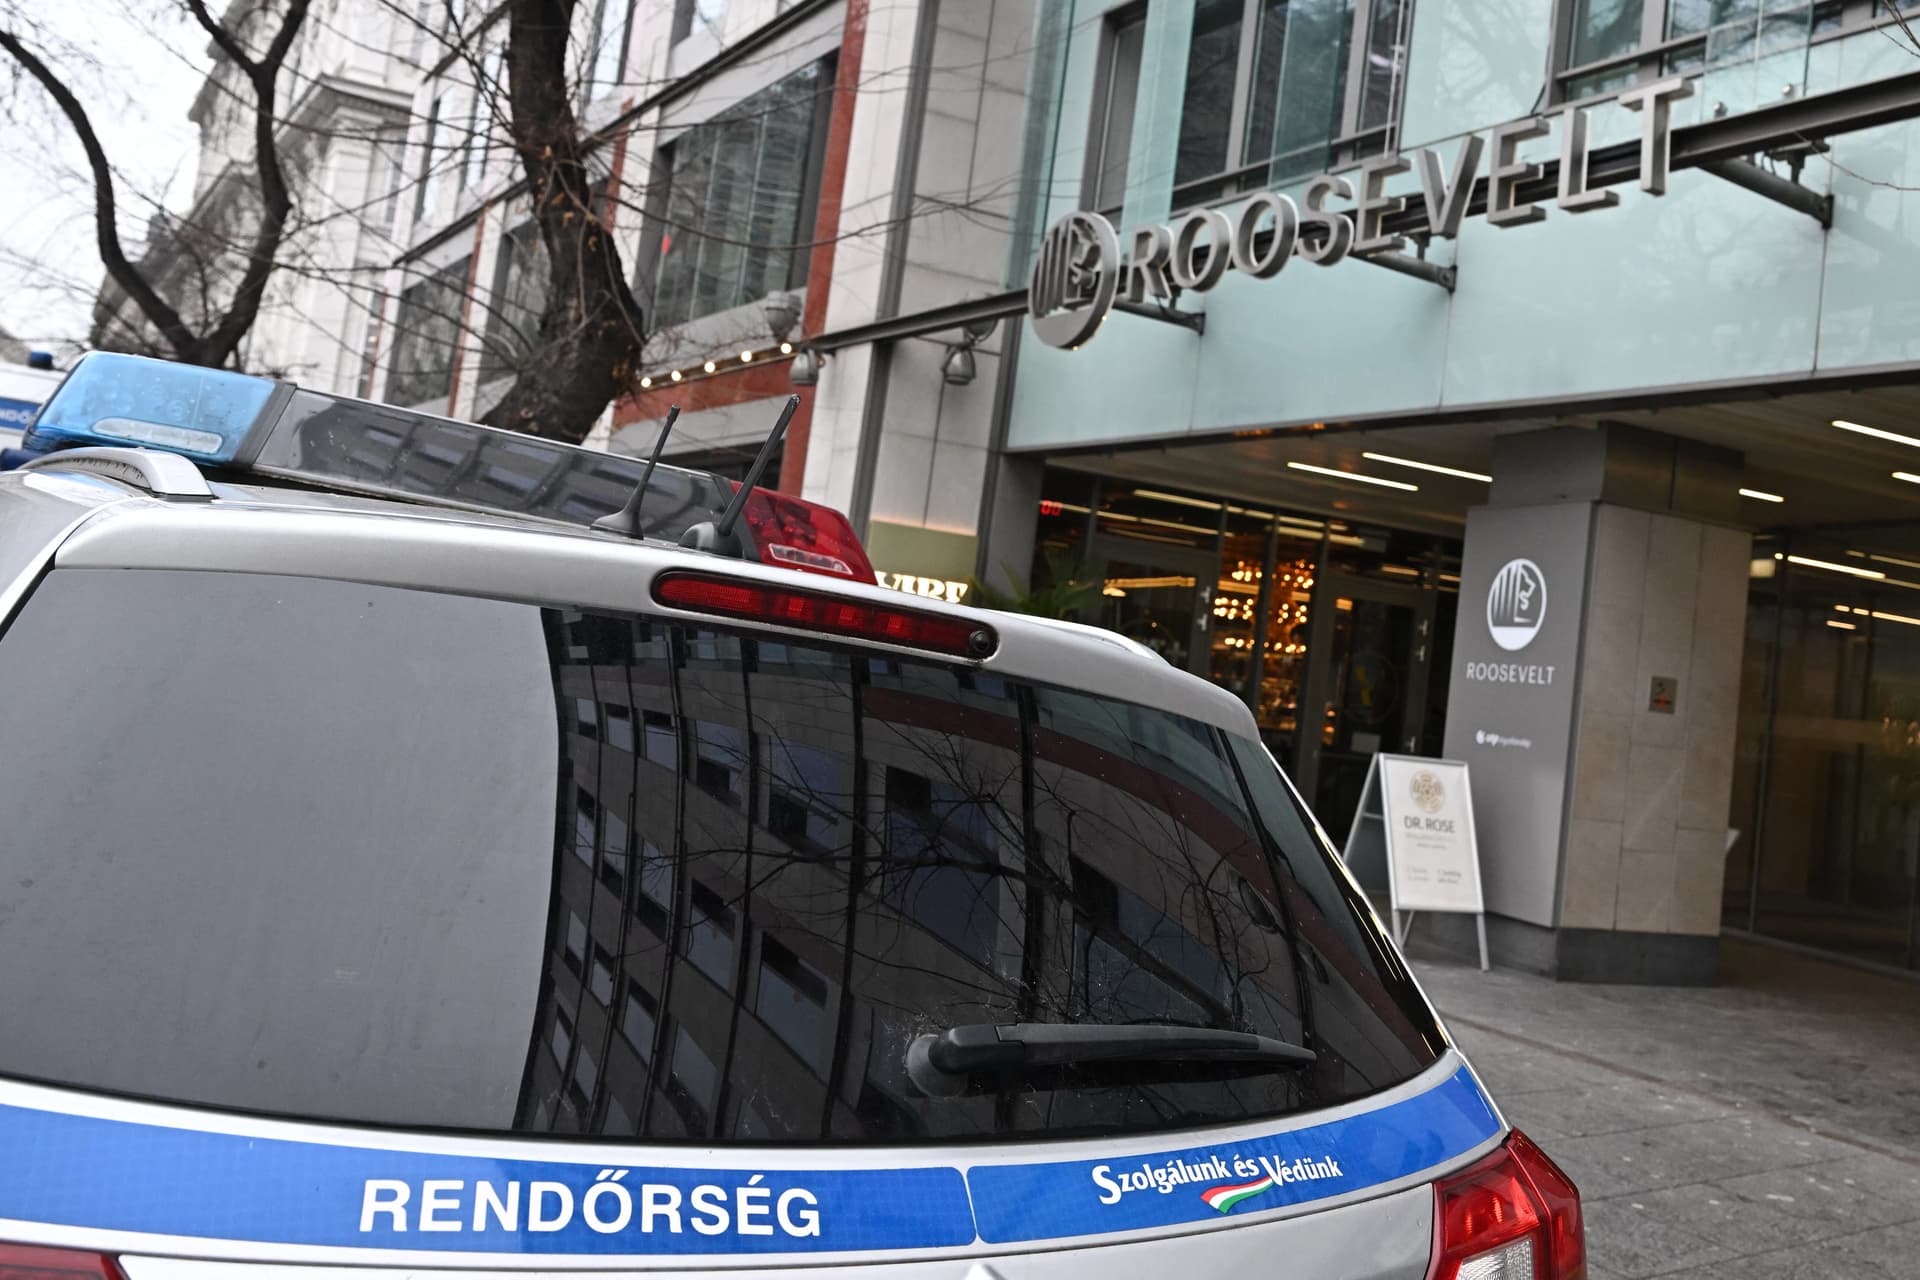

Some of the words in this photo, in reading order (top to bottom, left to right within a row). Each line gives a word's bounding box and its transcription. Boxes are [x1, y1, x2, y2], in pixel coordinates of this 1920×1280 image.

[1126, 77, 1694, 302] ROOSEVELT
[1466, 662, 1555, 684] ROOSEVELT
[1426, 818, 1456, 834] ROSE
[360, 1169, 821, 1237] RENDŐRSÉG
[1092, 1155, 1232, 1205] Szolgálunk
[1234, 1154, 1260, 1177] és
[1259, 1155, 1343, 1186] Védünk
